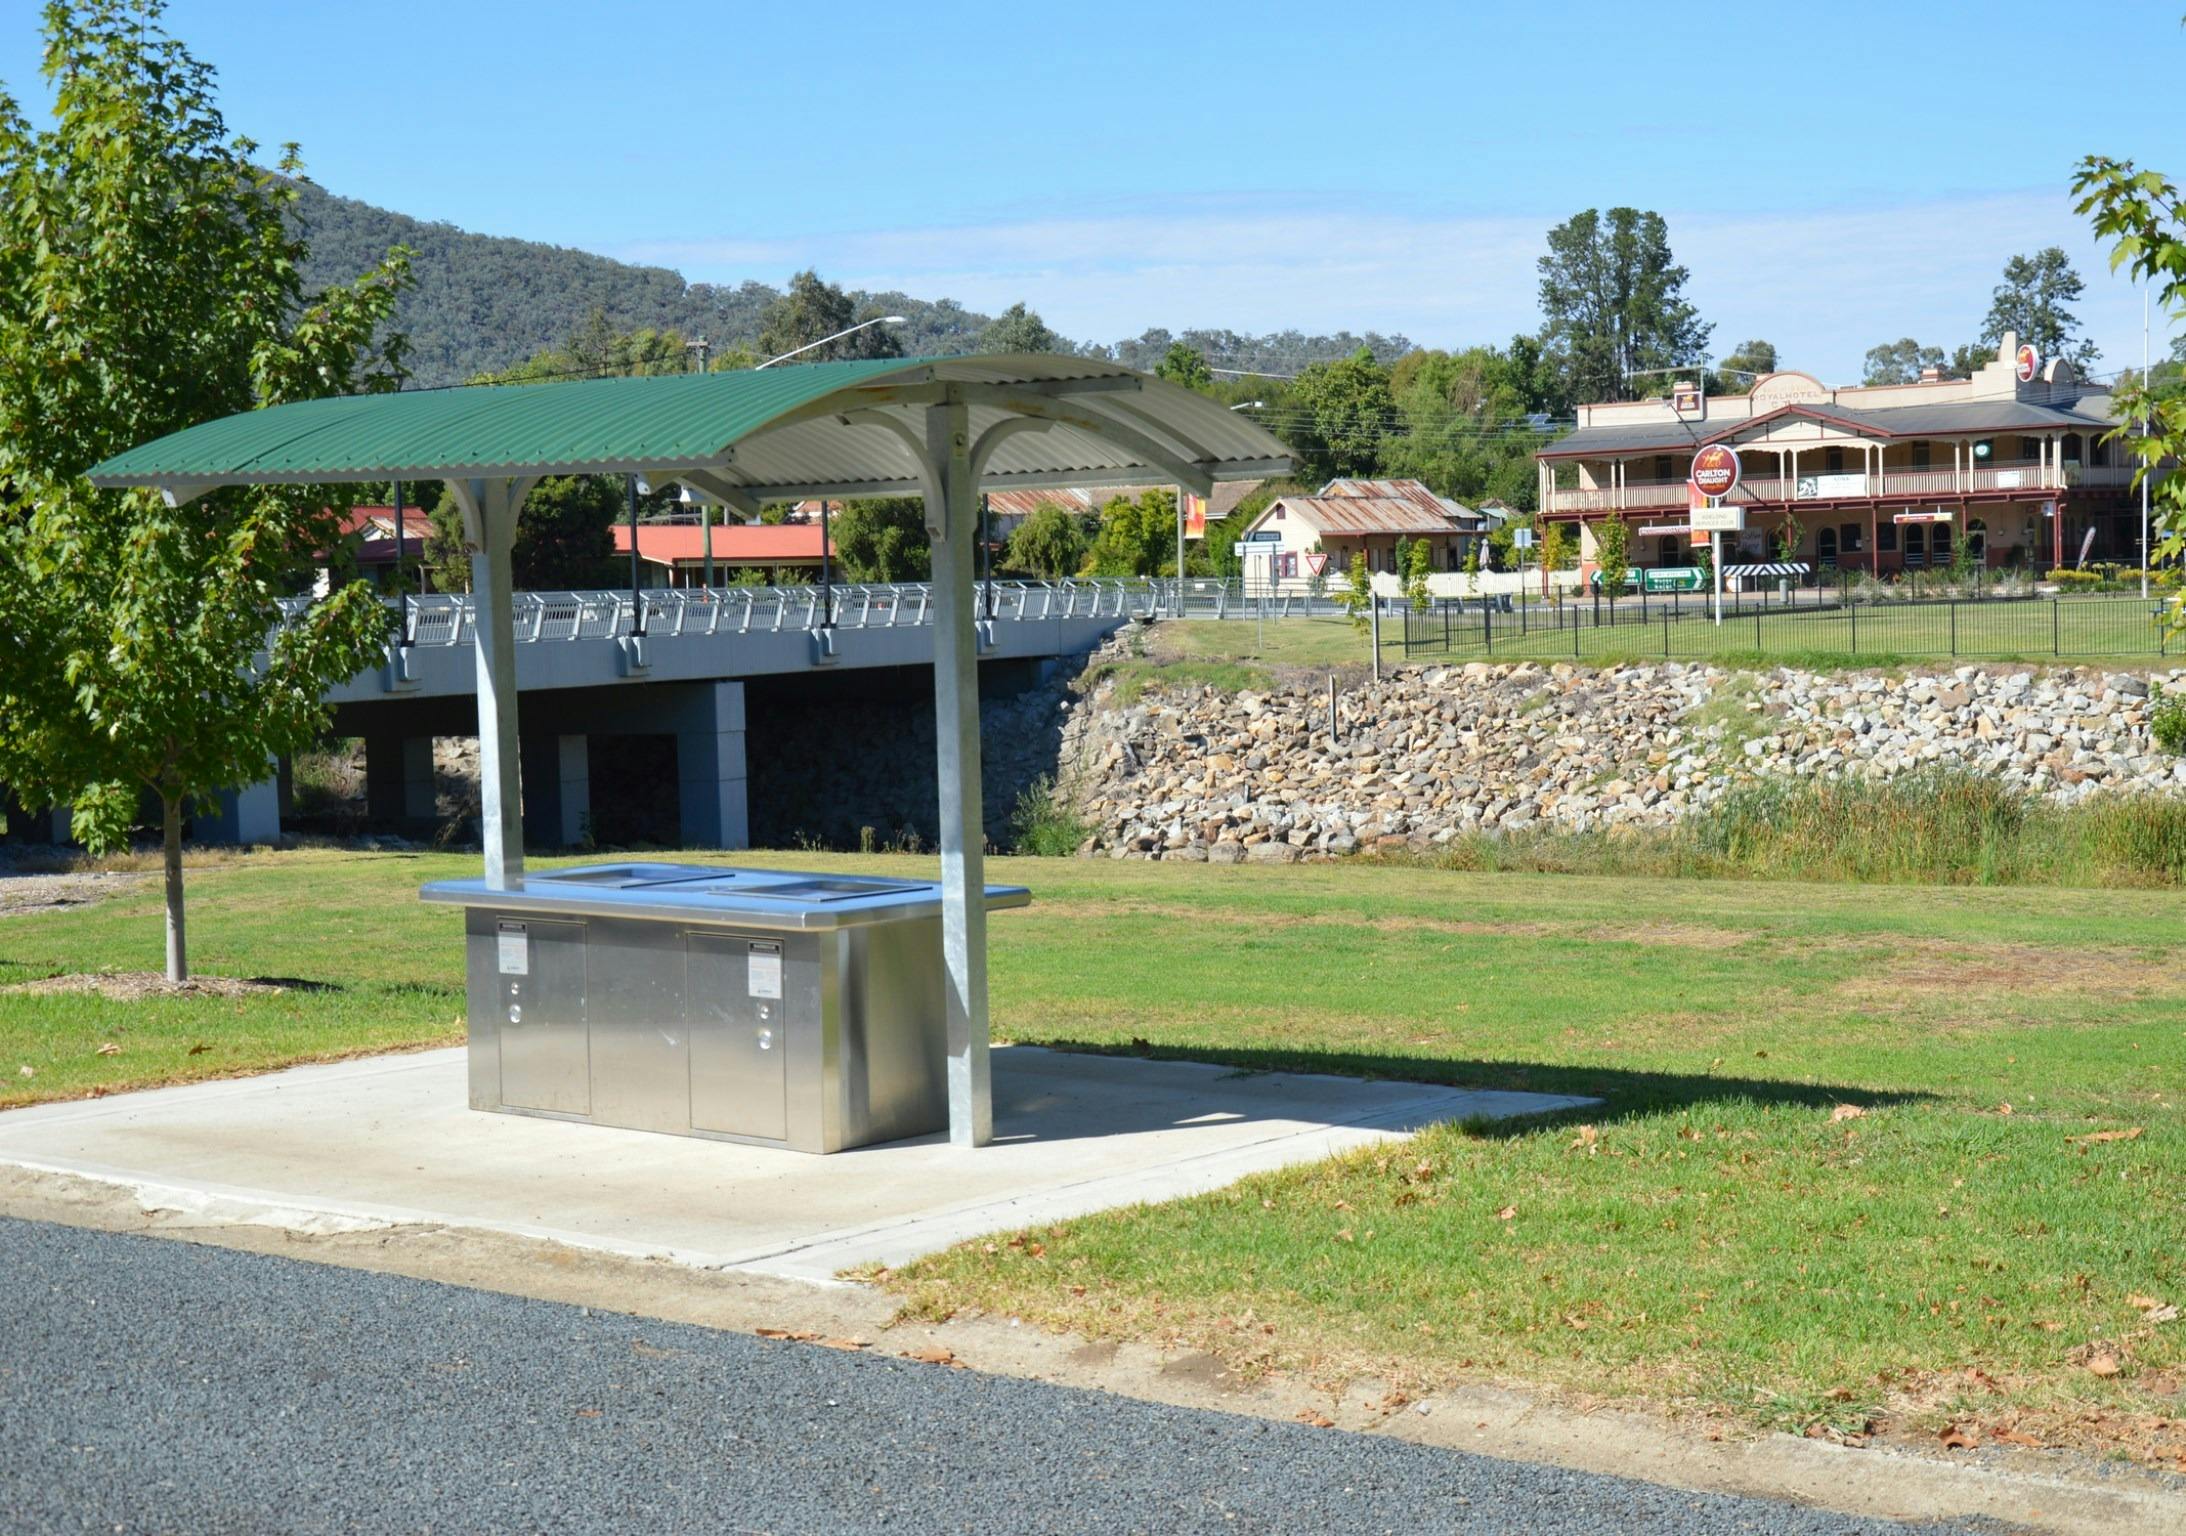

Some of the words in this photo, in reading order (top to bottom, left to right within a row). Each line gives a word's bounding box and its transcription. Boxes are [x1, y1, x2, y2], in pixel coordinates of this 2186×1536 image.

[1754, 393, 1785, 401] ROYAL
[1785, 391, 1818, 399] HOTEL
[1695, 469, 1731, 478] CARLTON
[1698, 477, 1728, 485] DRAUGHT
